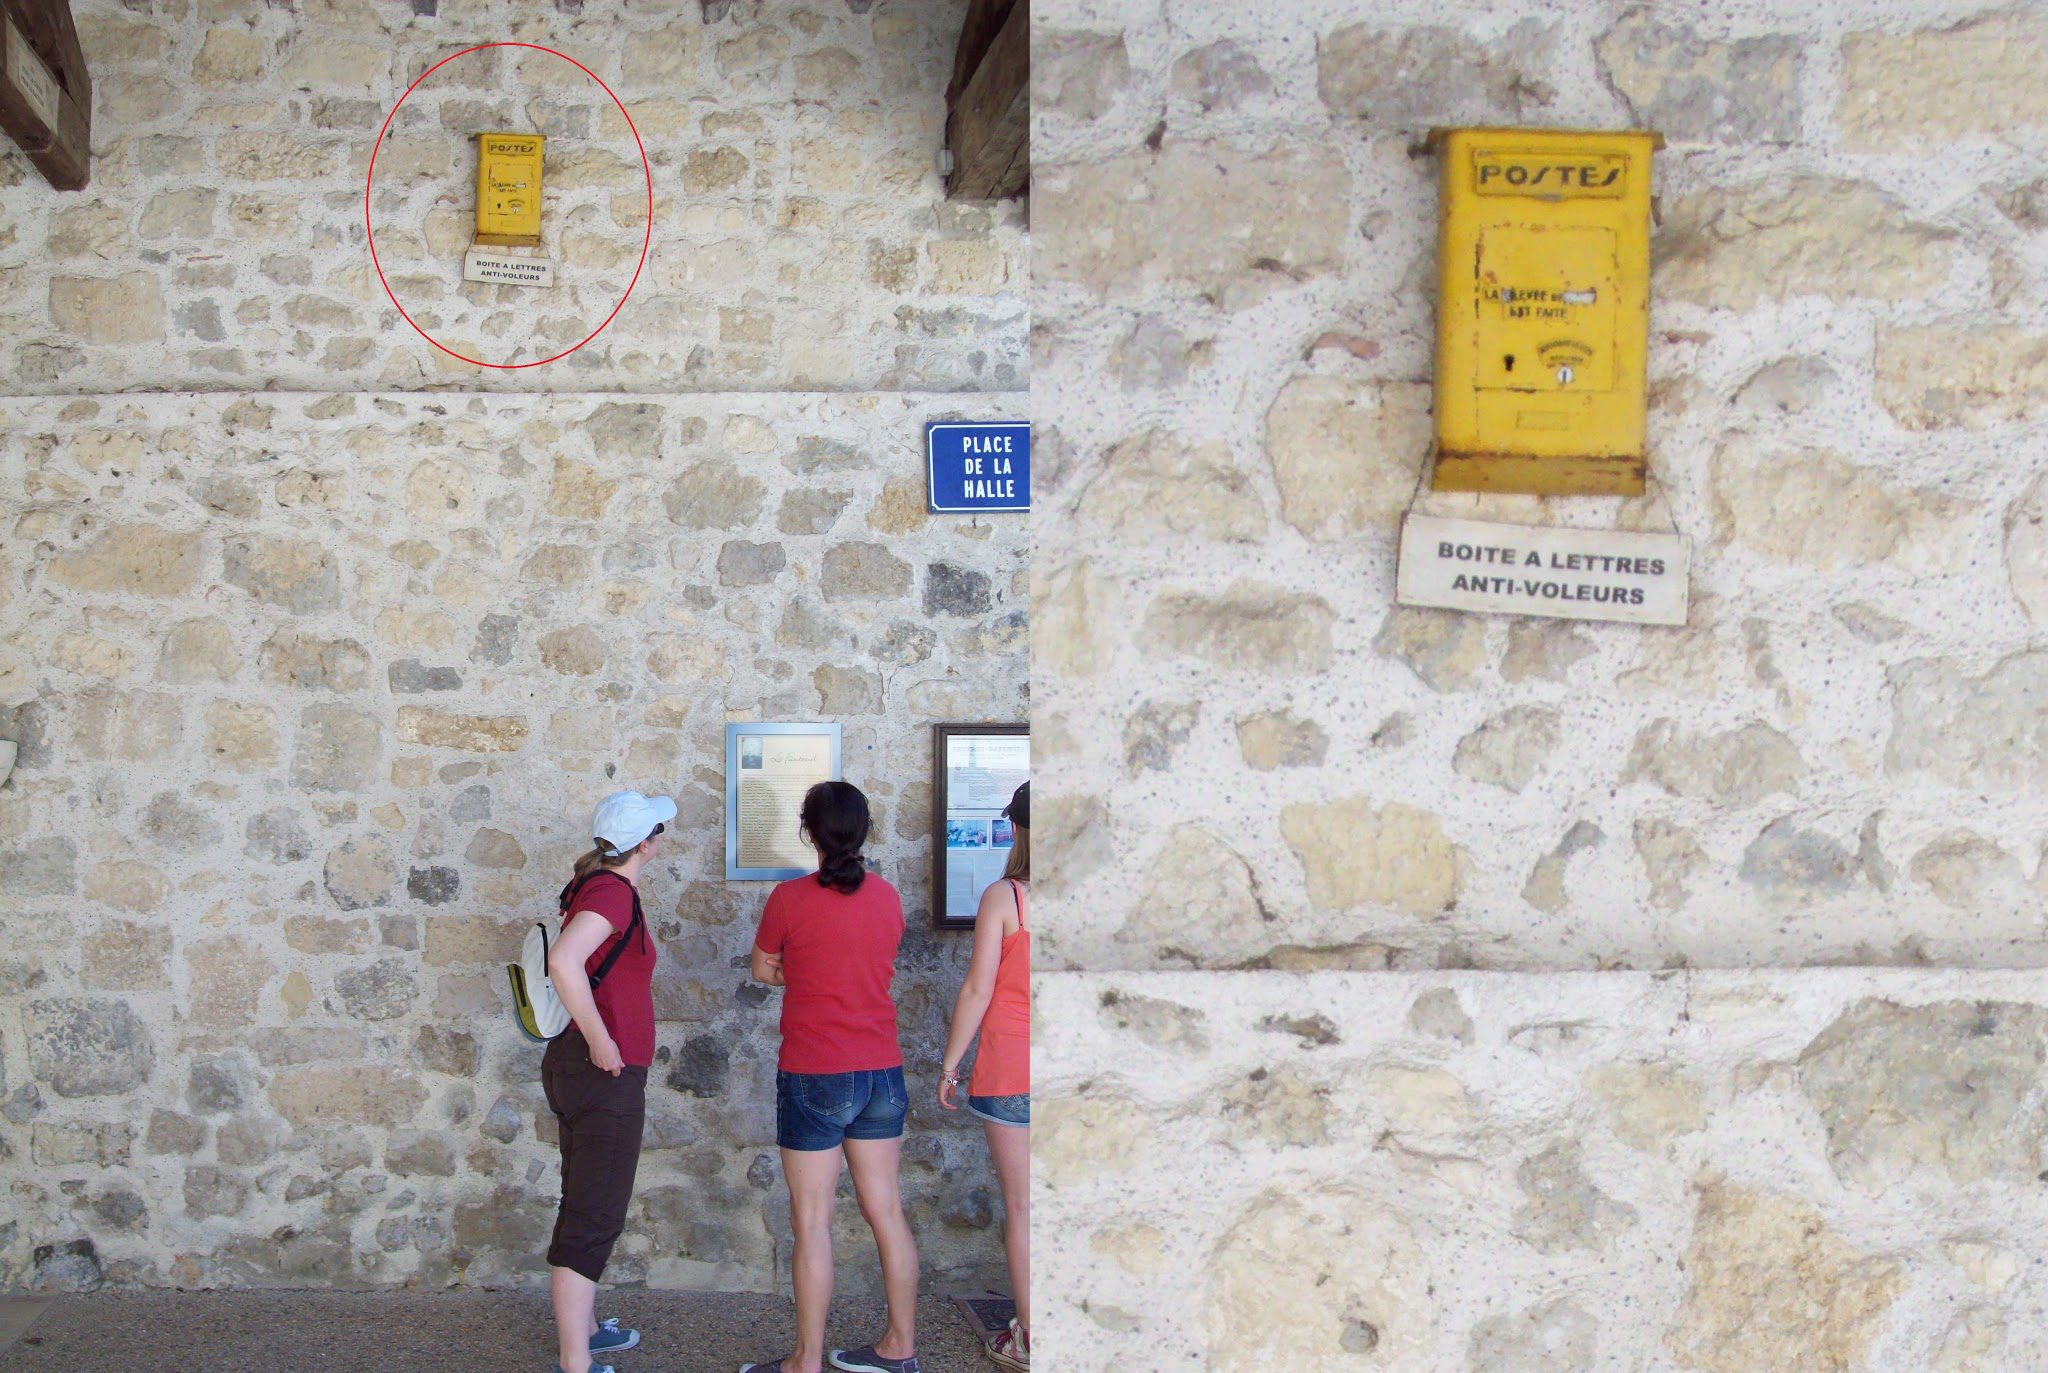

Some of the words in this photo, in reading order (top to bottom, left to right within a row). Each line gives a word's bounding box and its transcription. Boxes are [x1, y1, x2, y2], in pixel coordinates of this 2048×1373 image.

[490, 144, 534, 153] POSTES
[1480, 165, 1620, 187] POSTES
[476, 260, 500, 268] BOITE
[511, 264, 546, 272] LETTRES
[481, 270, 540, 281] ANTI-VOLEURS
[1484, 289, 1499, 300] LA
[963, 436, 1012, 453] PLACE
[965, 458, 983, 475] DE
[994, 458, 1012, 475] LA
[964, 479, 1015, 498] HALLE
[1438, 541, 1516, 565] BOITE
[1524, 550, 1542, 567] A
[1551, 552, 1665, 576] LETTRES
[1451, 573, 1645, 605] ANTI-VOLEURS
